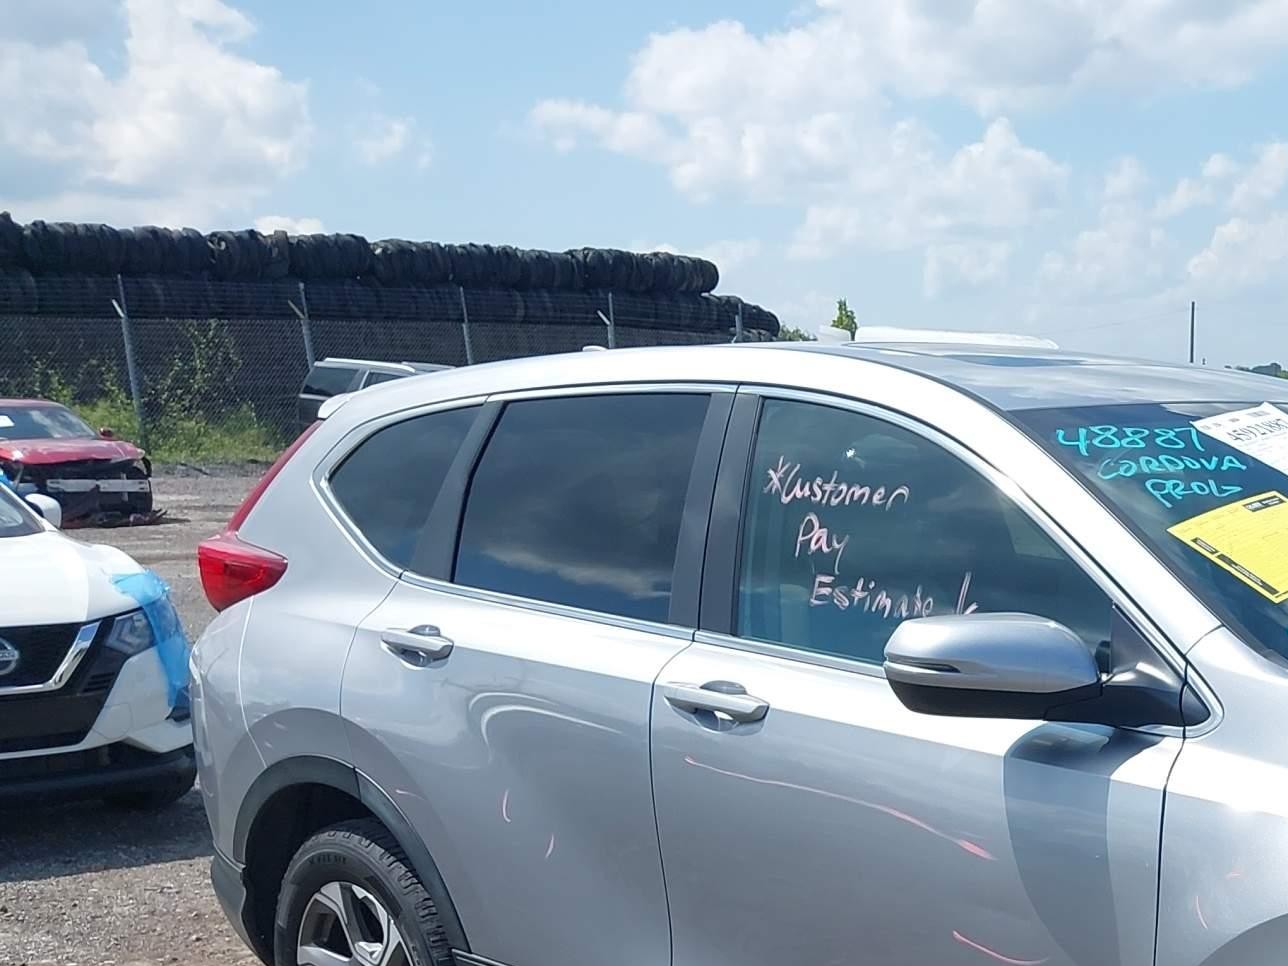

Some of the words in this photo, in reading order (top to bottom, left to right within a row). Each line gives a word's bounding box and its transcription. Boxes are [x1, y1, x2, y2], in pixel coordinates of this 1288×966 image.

[1098, 455, 1247, 480] CORDOVA
[795, 512, 850, 575] Pay
[810, 573, 934, 618] Estimate
